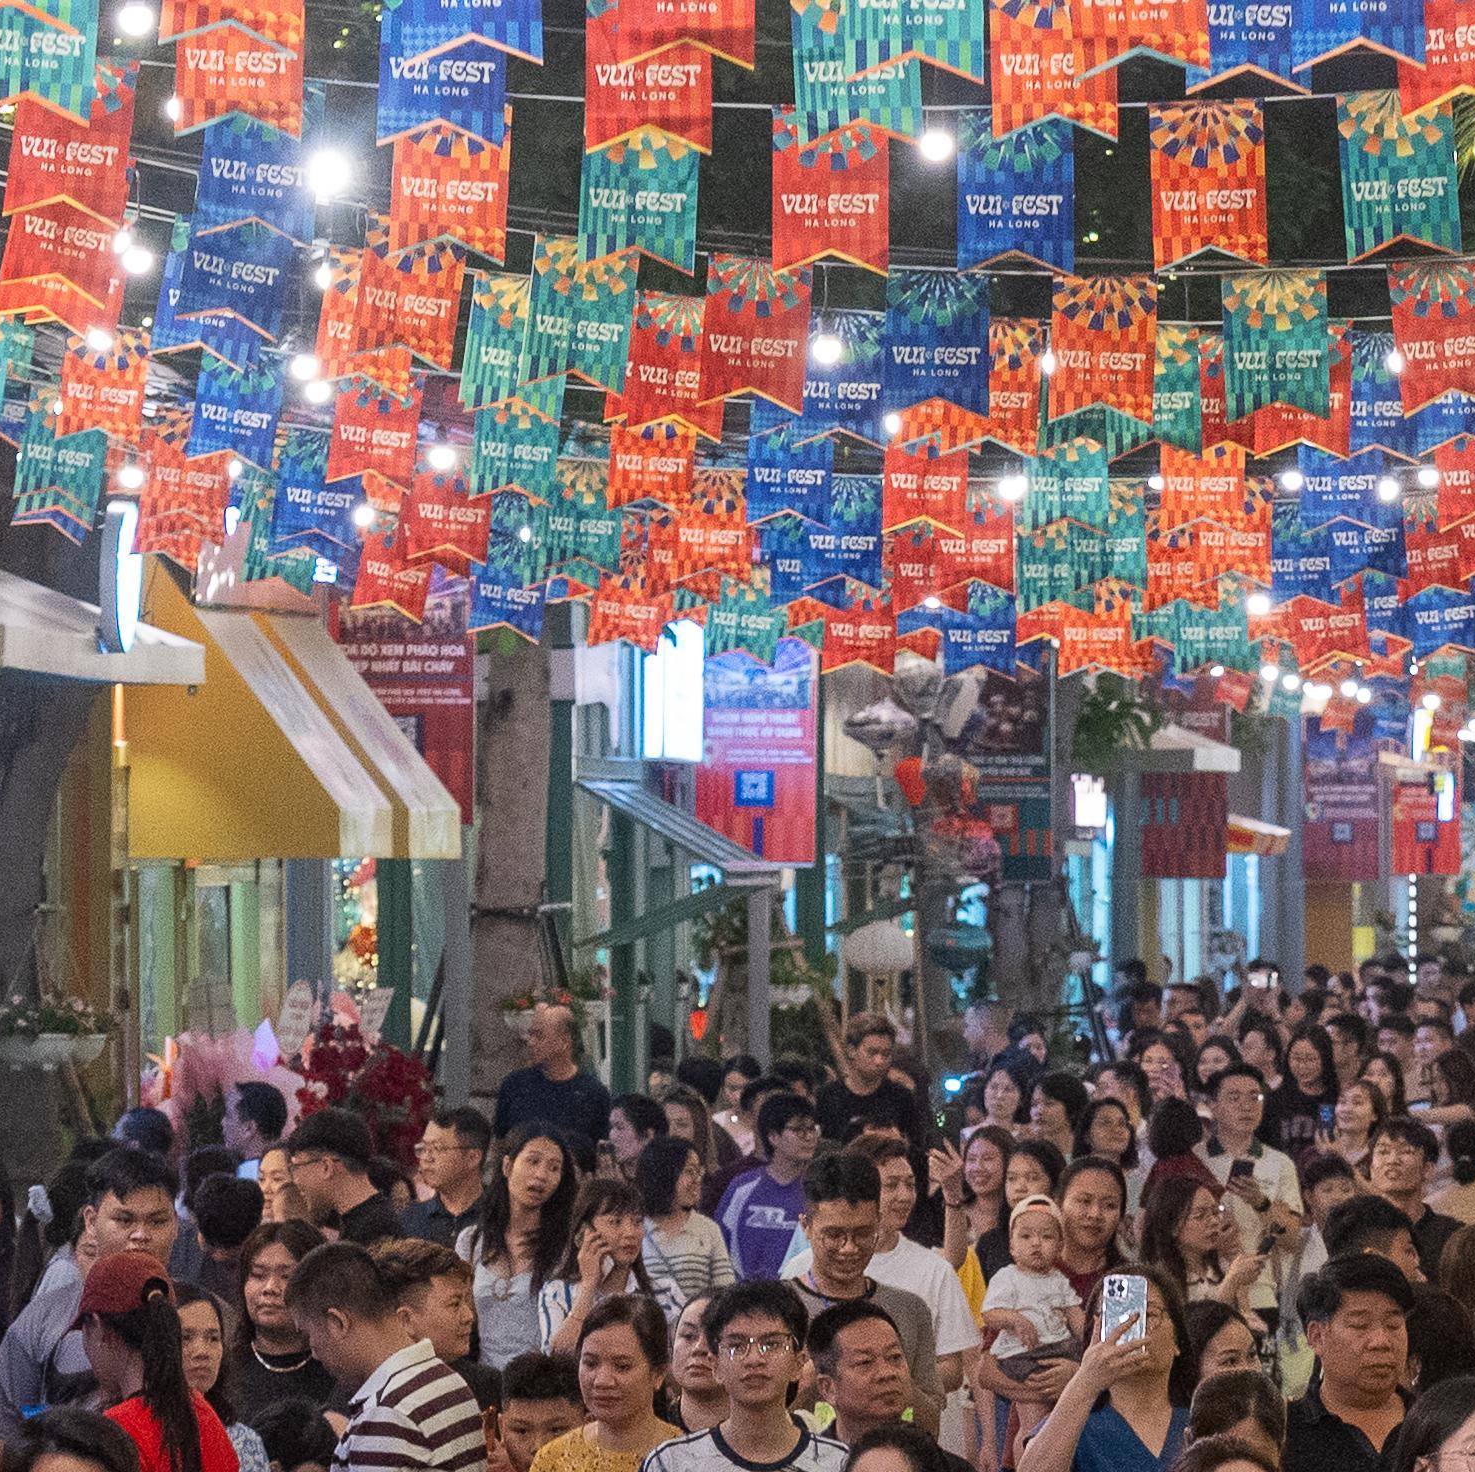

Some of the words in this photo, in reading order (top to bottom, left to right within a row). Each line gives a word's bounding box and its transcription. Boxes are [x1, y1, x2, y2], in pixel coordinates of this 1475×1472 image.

[30, 30, 86, 56] FEST
[4, 57, 20, 65] HA
[26, 59, 58, 69] LONG
[186, 48, 224, 71] VUI
[234, 52, 291, 73] FEST
[439, 60, 495, 83] FEST
[596, 61, 634, 86] VUI
[646, 65, 701, 86] FEST
[209, 77, 224, 85] HA
[231, 78, 265, 87] LONG
[435, 87, 469, 96] LONG
[621, 91, 635, 100] HA
[642, 92, 676, 101] LONG
[21, 136, 56, 158] VUI
[66, 142, 118, 166] FEST
[41, 163, 54, 171] HA
[61, 165, 92, 176] LONG
[211, 158, 247, 180] VUI
[256, 162, 305, 185] FEST
[401, 176, 436, 198] VUI
[446, 180, 498, 201] FEST
[1351, 180, 1391, 201] VUI
[1397, 177, 1447, 198] FEST
[442, 205, 473, 213] LONG
[590, 188, 631, 209] VUI
[635, 191, 687, 212] FEST
[781, 194, 817, 213] VUI
[828, 194, 879, 214] FEST
[966, 195, 1001, 215] VUI
[1012, 195, 1063, 215] FEST
[1161, 191, 1196, 210] VUI
[1205, 189, 1256, 209] FEST
[1395, 202, 1426, 212] LONG
[631, 216, 662, 224] LONG
[825, 219, 856, 227] LONG
[1009, 220, 1039, 228] LONG
[1183, 216, 1198, 224] HA
[1202, 214, 1234, 223] LONG
[365, 286, 396, 309] VUI
[401, 294, 451, 317] FEST
[709, 334, 742, 353] VUI
[751, 338, 799, 357] FEST
[1402, 342, 1435, 361] VUI
[893, 347, 925, 364] VUI
[934, 347, 981, 365] FEST
[1056, 353, 1089, 371] VUI
[1099, 352, 1145, 370] FEST
[1234, 351, 1267, 369] VUI
[1276, 349, 1321, 368] FEST
[1443, 359, 1471, 369] LONG
[481, 441, 507, 457] VUI
[514, 445, 552, 461] FEST
[754, 467, 786, 483] VUI
[788, 469, 825, 485] FEST
[890, 473, 917, 489] VUI
[924, 476, 961, 491] FEST
[1305, 475, 1331, 491] VUI
[1339, 473, 1376, 491] FEST
[949, 630, 972, 642] VUI
[977, 630, 1010, 642] FEST
